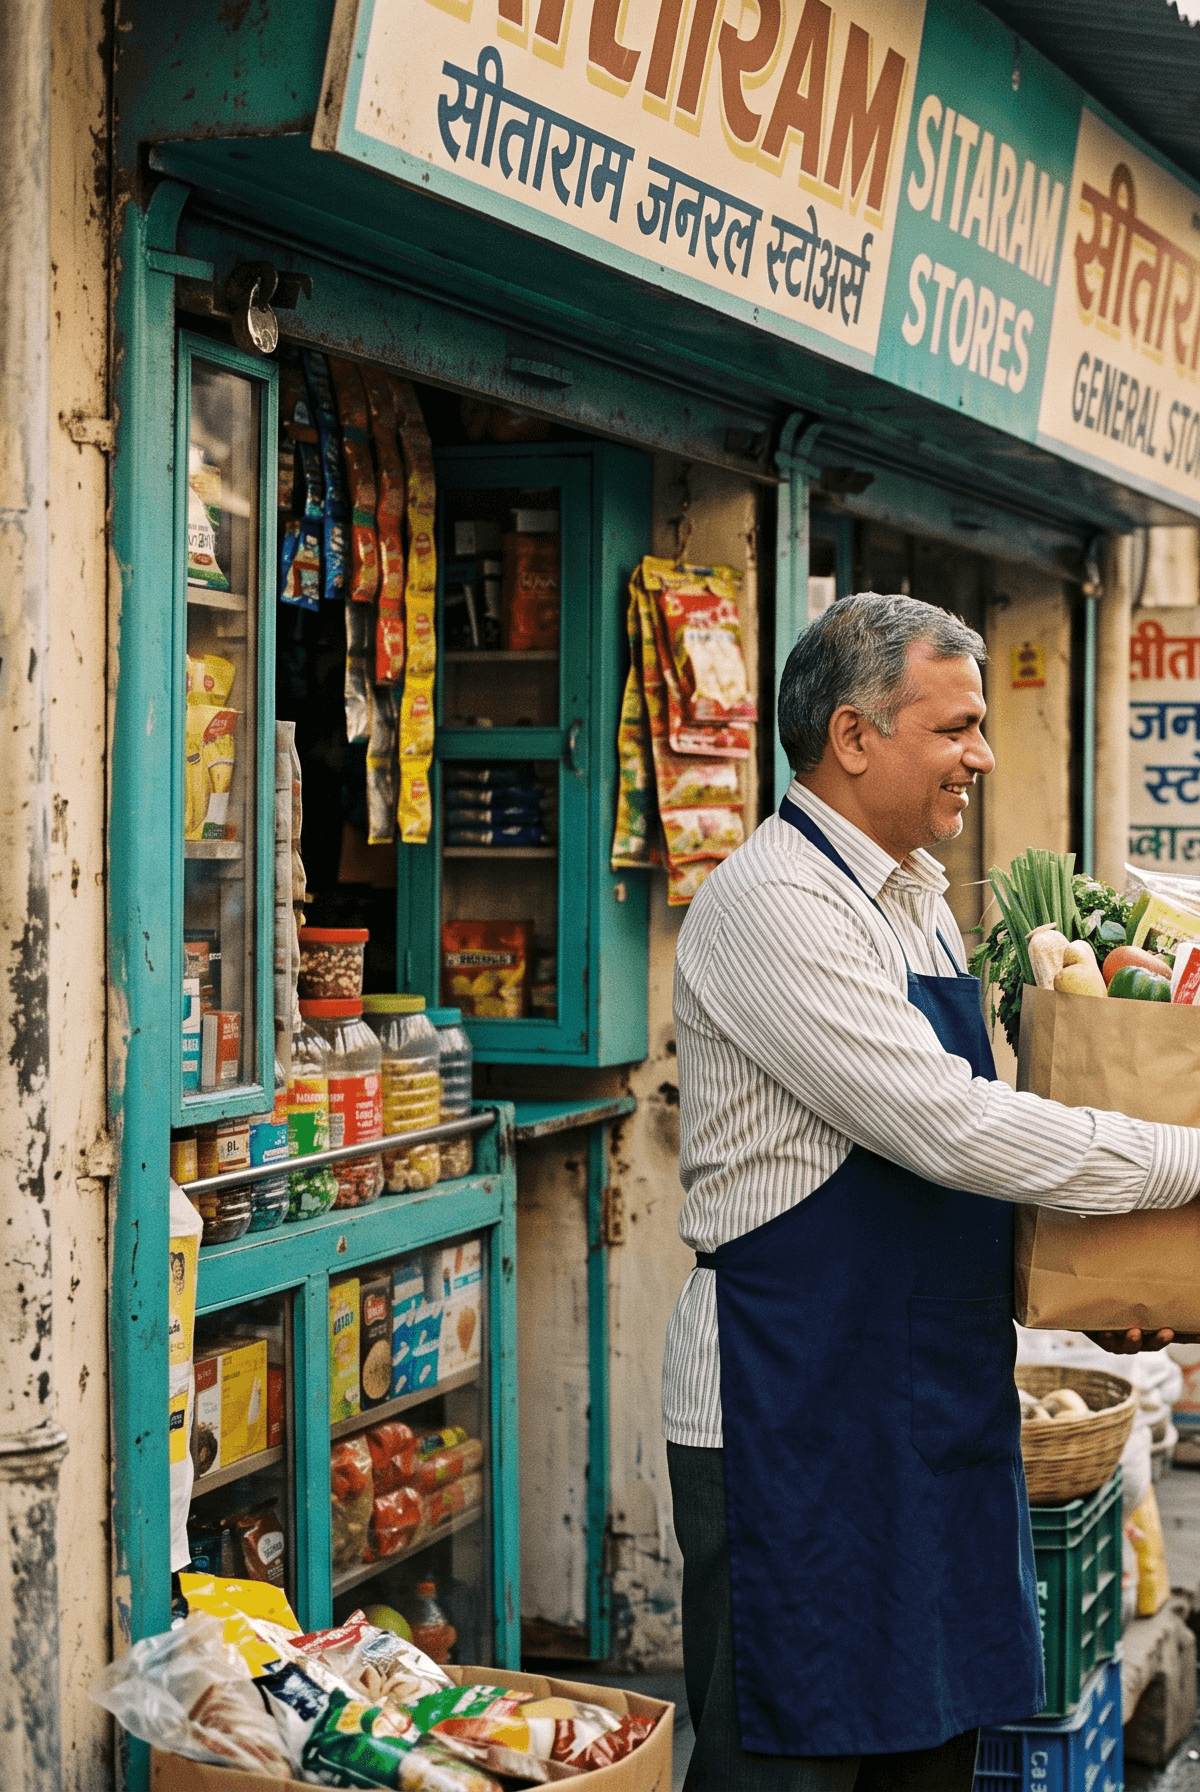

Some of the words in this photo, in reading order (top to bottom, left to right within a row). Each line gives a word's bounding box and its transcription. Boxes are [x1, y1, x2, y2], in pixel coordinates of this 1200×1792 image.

[437, 46, 635, 223] सीताराम
[637, 157, 763, 278] जनरल
[907, 94, 1064, 287] SITARAM
[902, 253, 1034, 394] STORES
[1070, 352, 1159, 459] GENERAL
